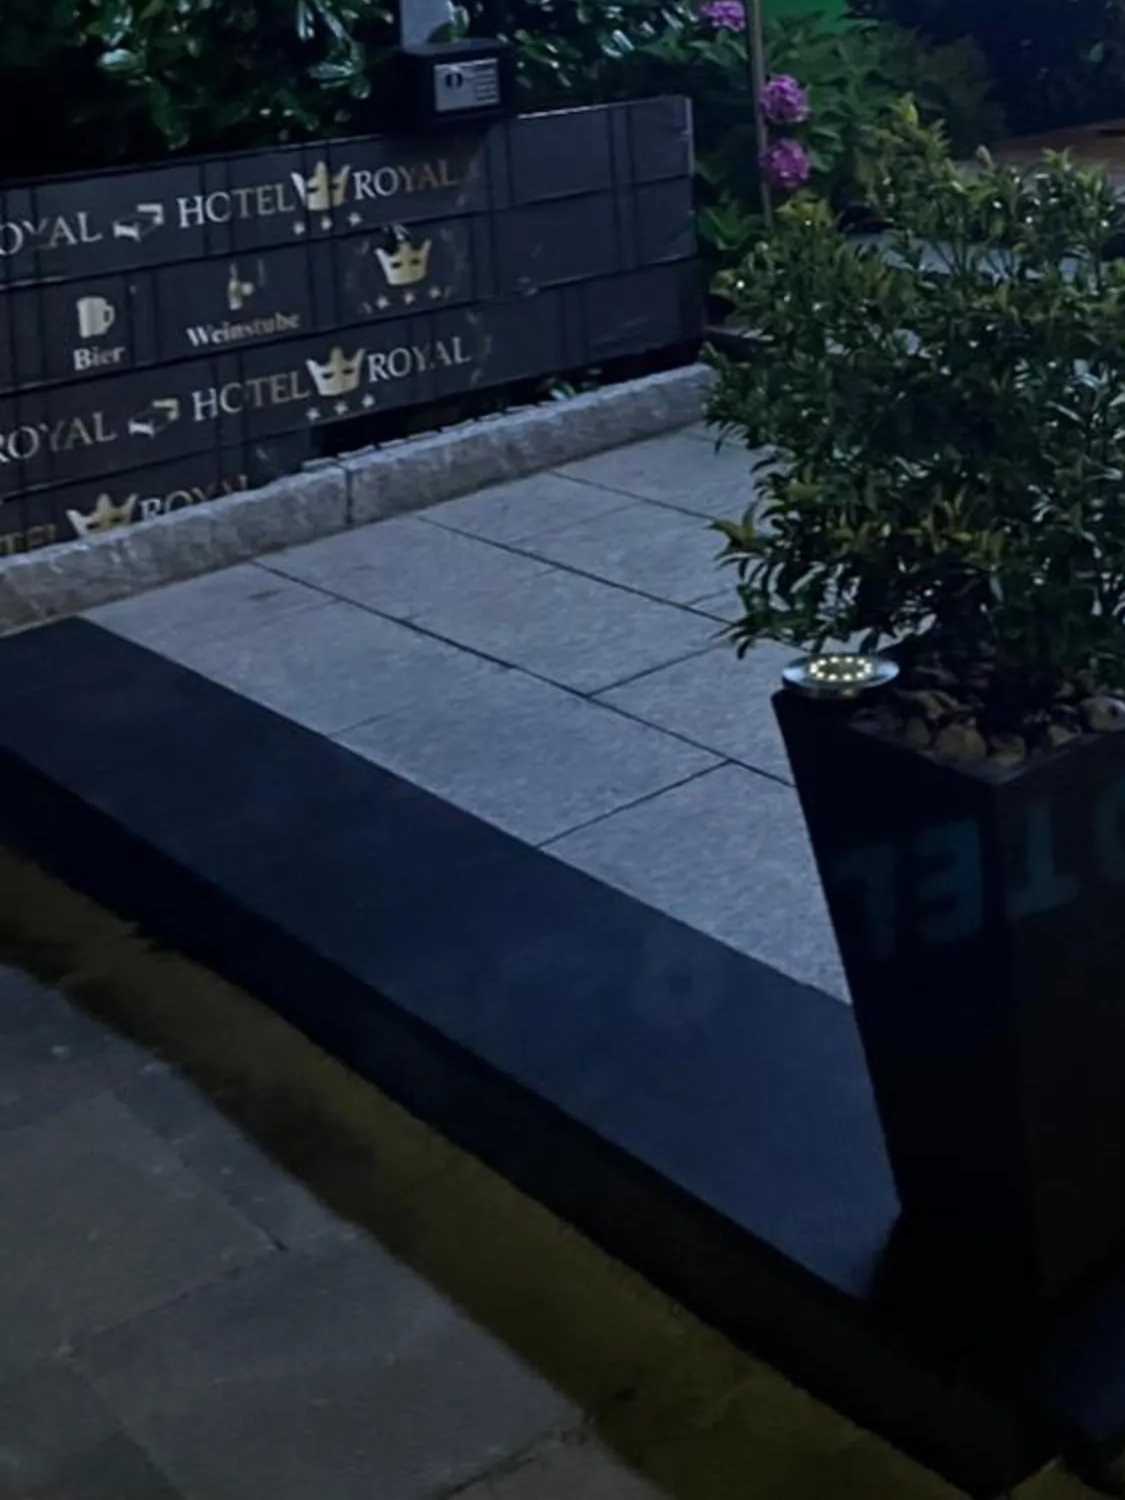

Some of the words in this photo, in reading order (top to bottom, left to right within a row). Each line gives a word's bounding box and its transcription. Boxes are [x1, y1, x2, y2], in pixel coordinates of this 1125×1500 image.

[0, 211, 103, 257] OYAL
[353, 159, 460, 201] ROYAL
[186, 312, 301, 348] Weinstube
[73, 345, 125, 371] Bier
[367, 335, 472, 384] ROYAL
